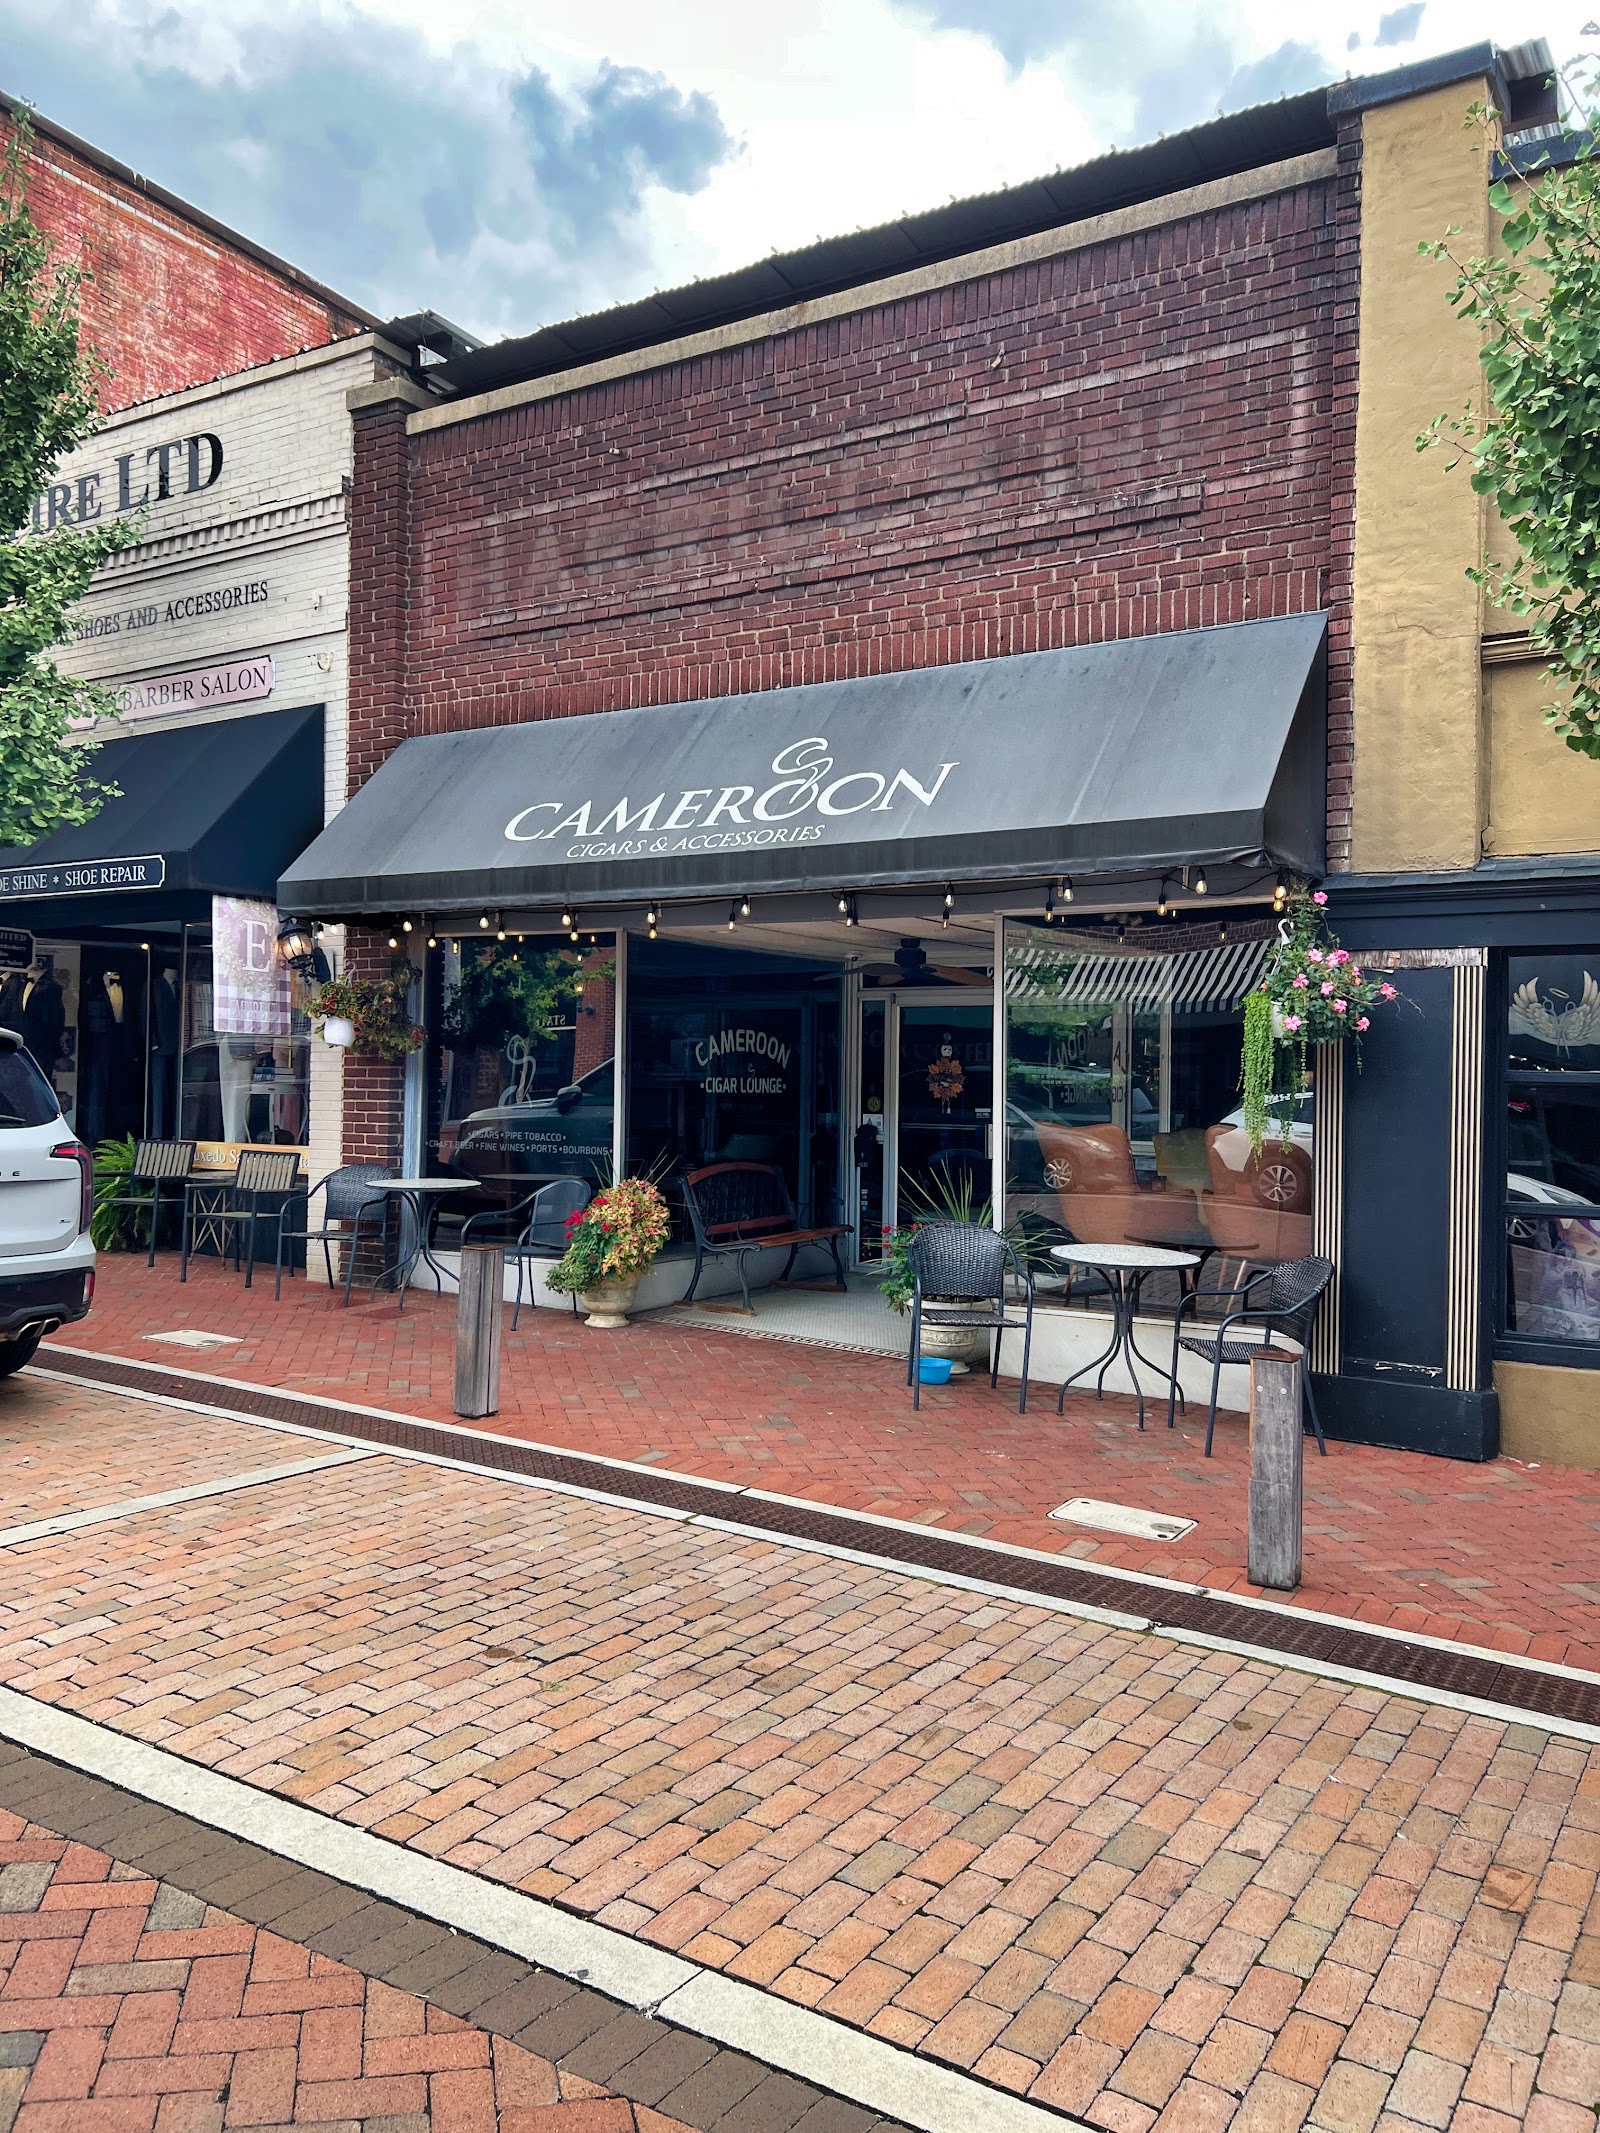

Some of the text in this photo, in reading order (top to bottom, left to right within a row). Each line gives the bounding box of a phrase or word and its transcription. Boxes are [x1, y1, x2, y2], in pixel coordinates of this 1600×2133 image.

[30, 432, 224, 536] IRE LTD
[77, 581, 268, 640] SHOES AND ACCESSORIES
[122, 665, 267, 712] BARBER SALON
[504, 762, 960, 841] CAMEROON
[566, 825, 825, 858] CIGARS & ACCESSORIES
[12, 873, 48, 891] SHINE
[65, 869, 98, 886] SHOE
[100, 865, 146, 883] REPAIR
[242, 919, 270, 972] E
[695, 1029, 790, 1070] CAMEROON
[705, 1077, 782, 1094] CIGAR LOUNGE
[429, 1140, 609, 1156] CRAFT BEER FINE WINES PORTS BOURBONS
[471, 1130, 562, 1142] CIGARS PIPE TOBACCO
[193, 1148, 226, 1164] uxedo
